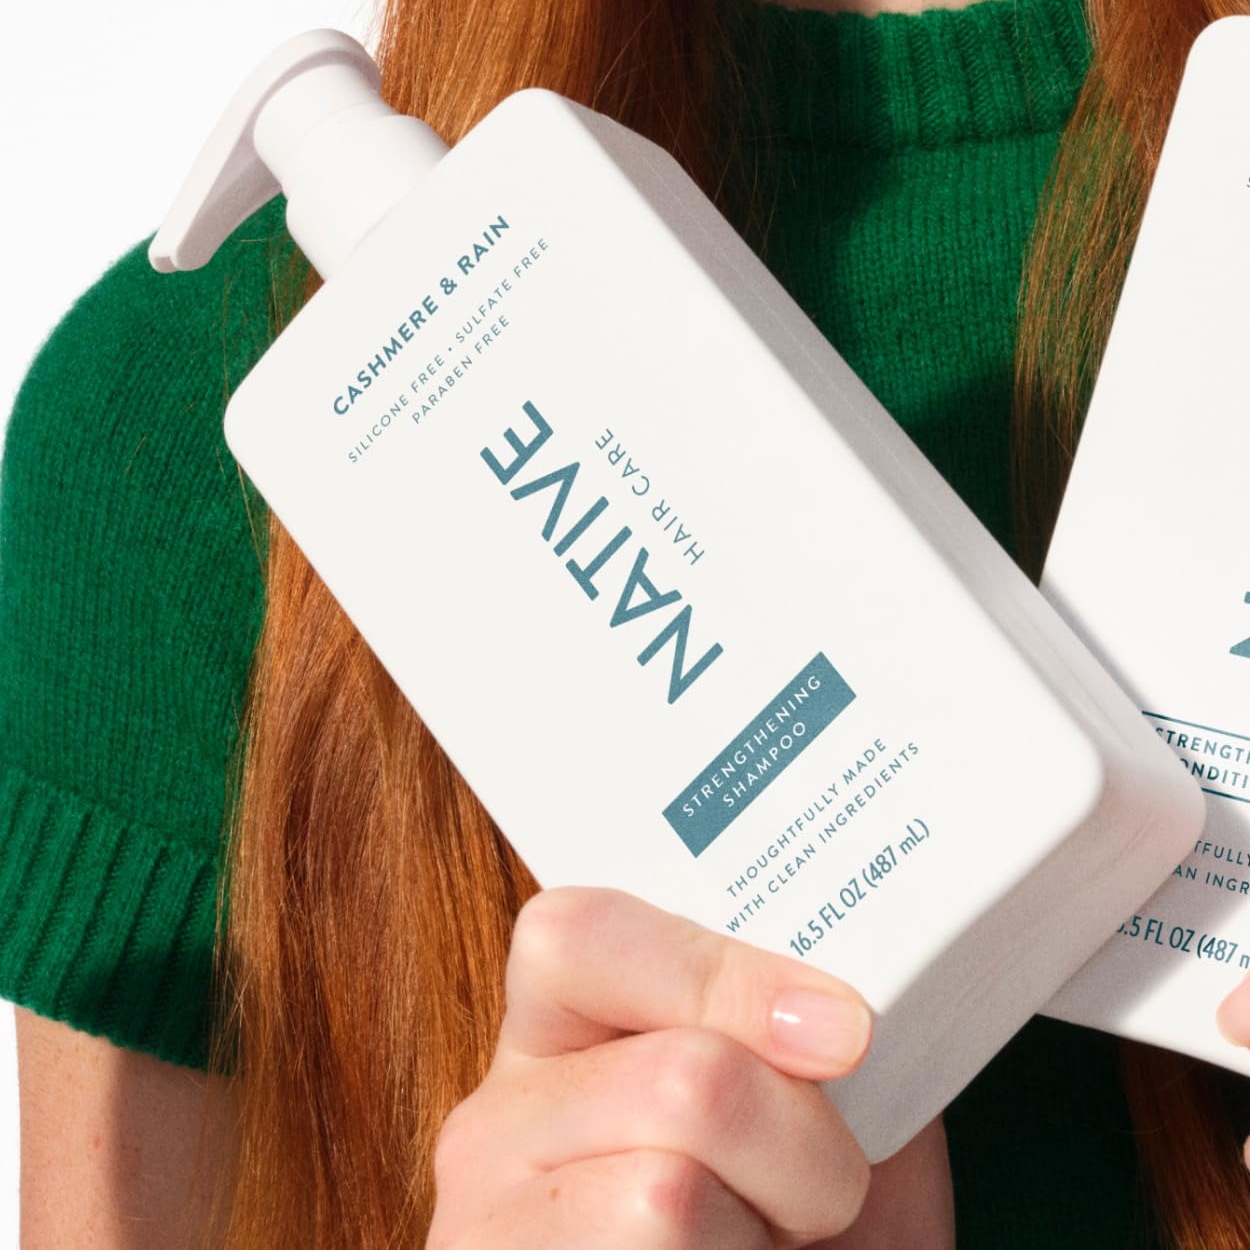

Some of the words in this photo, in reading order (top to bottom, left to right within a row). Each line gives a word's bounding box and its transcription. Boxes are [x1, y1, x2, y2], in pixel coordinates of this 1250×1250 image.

[333, 295, 439, 415] CASHMERE
[439, 277, 458, 296] &
[456, 214, 510, 276] RAIN
[348, 394, 409, 463] SILICONE
[410, 354, 445, 394] FREE
[455, 278, 513, 344] SULFATE
[513, 238, 551, 279] FREE
[411, 355, 473, 425] PARABEN
[474, 315, 510, 355] FREE
[594, 428, 650, 496] CARE
[479, 399, 724, 705] NATIVE
[651, 499, 705, 566] HAIR
[682, 675, 821, 817] STRENGTHENING
[722, 721, 806, 807] SHAMPOO
[725, 893, 766, 933] WITH
[767, 843, 817, 894] CLEAN
[818, 742, 919, 844] INGREDIENTS
[726, 782, 839, 898] THOUGHTFULLY
[843, 738, 887, 786] MADE
[789, 919, 825, 957] 16.5
[818, 902, 846, 929] FL
[839, 878, 867, 909] OZ
[862, 844, 898, 889] (487
[898, 818, 930, 855] mL)
[1143, 918, 1164, 946] FL
[1169, 925, 1196, 953] OZ
[1196, 933, 1239, 964] (487
